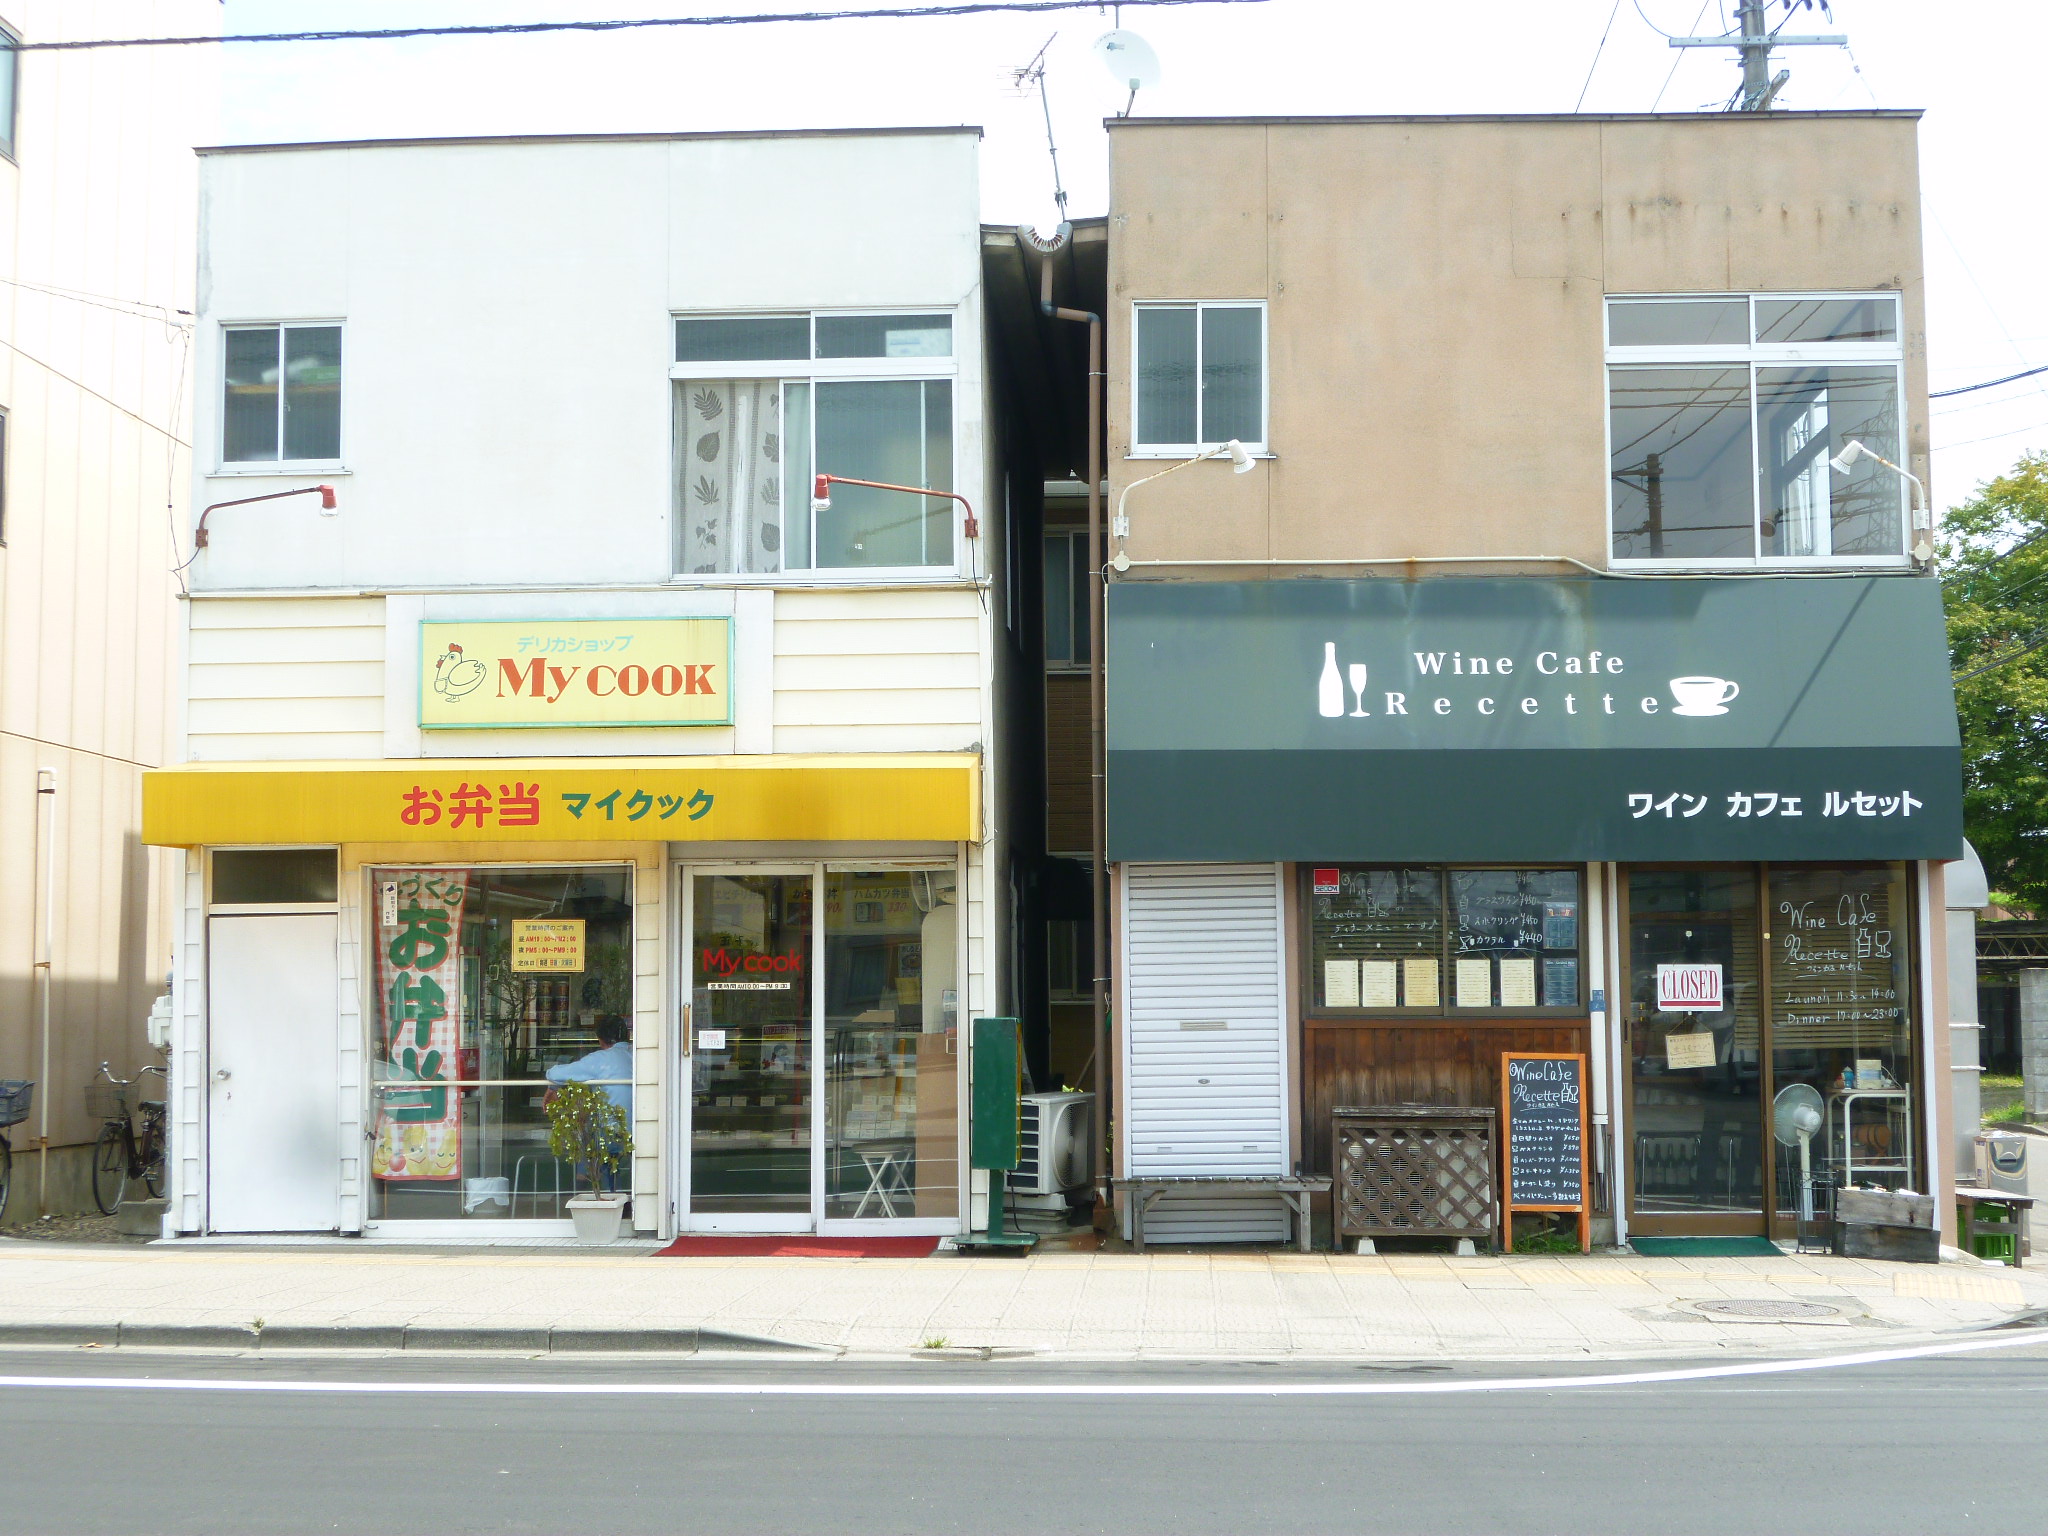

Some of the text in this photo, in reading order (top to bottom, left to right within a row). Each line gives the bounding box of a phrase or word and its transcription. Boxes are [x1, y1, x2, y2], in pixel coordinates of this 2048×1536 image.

[516, 635, 634, 653] デリカショップ
[1413, 651, 1625, 676] Wine Cafe
[495, 657, 581, 703] My
[1385, 691, 1660, 716] Recette
[401, 782, 715, 829] お弁当 マイクック
[1628, 790, 1924, 819] ワイン カフェ ルセット
[1780, 893, 1877, 929] Wine Cafe
[1519, 930, 1543, 945] ¥440
[1783, 934, 1848, 963] Recette
[703, 948, 804, 977] My cook
[1662, 969, 1718, 999] CLOSED
[1788, 1013, 1831, 1024] Dinner
[1510, 1060, 1572, 1081] Wine Cafe
[1513, 1083, 1560, 1104] Recette
